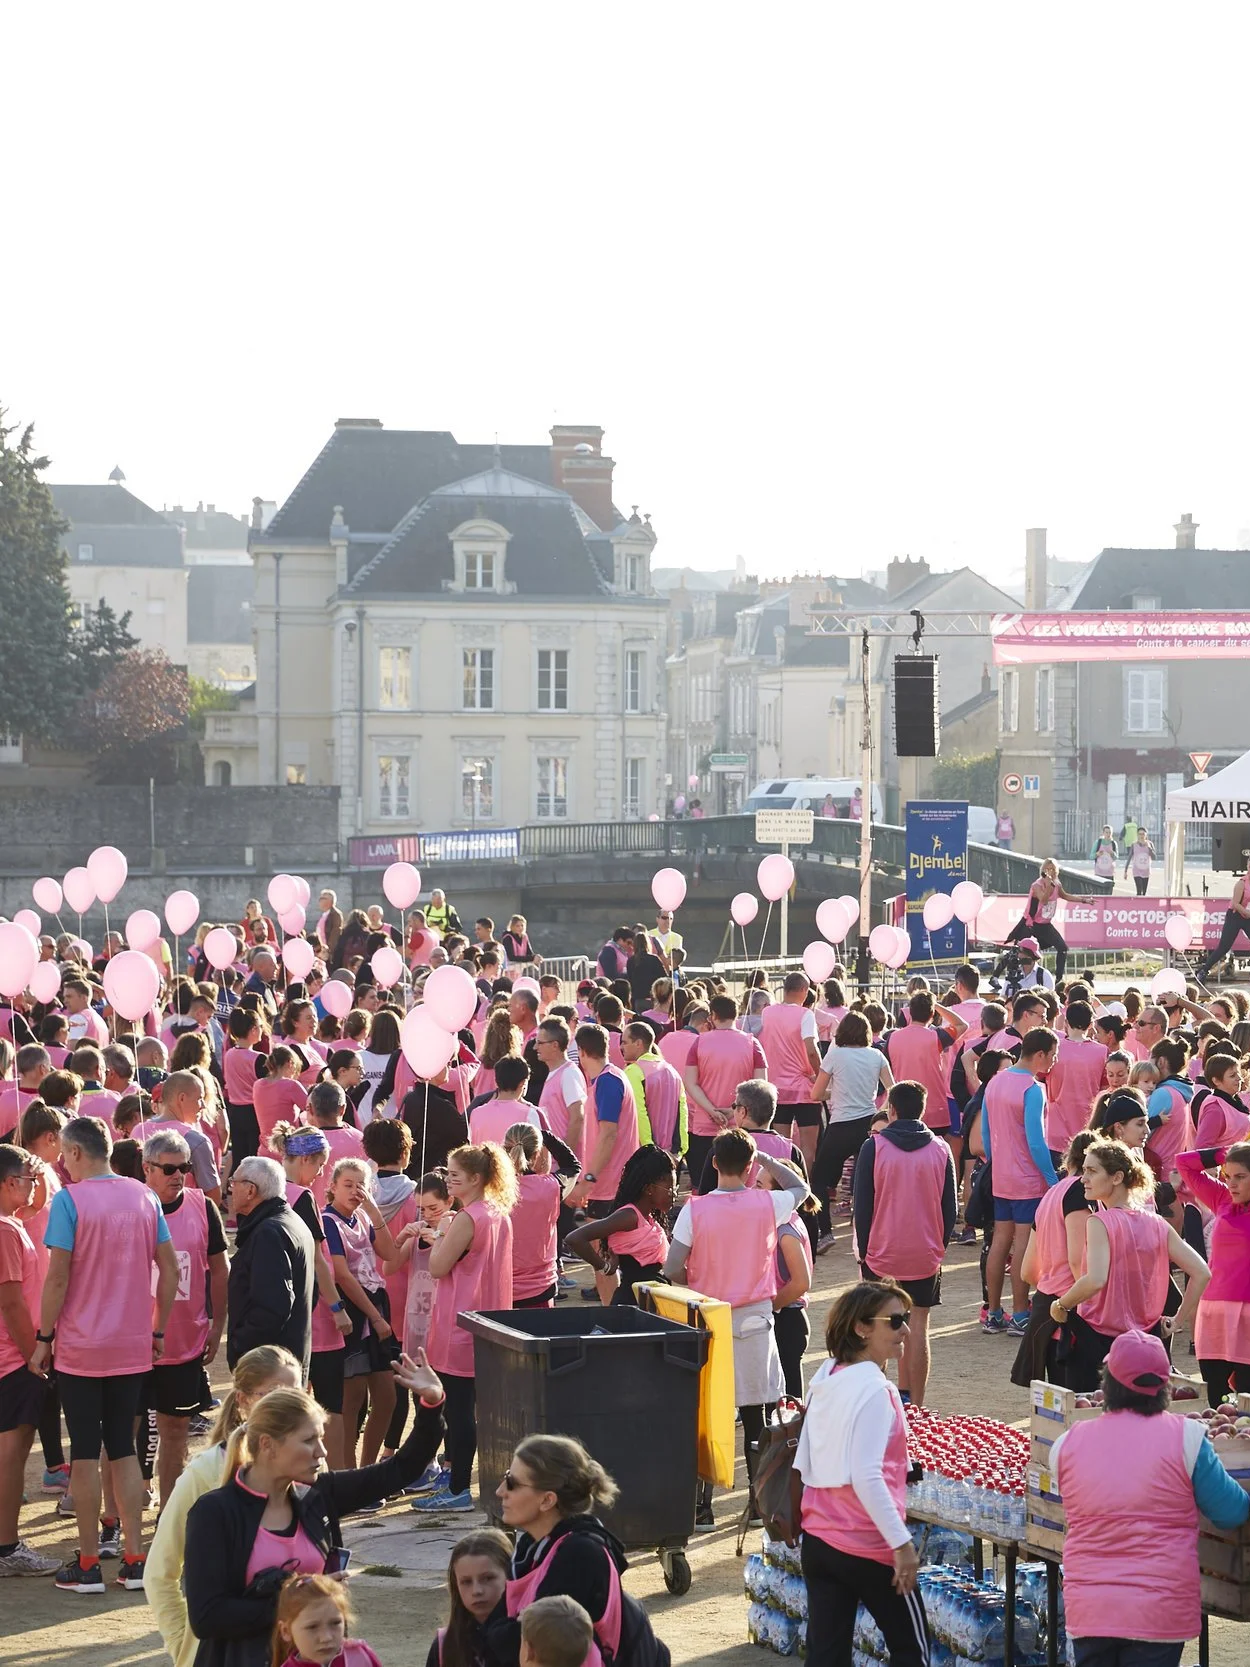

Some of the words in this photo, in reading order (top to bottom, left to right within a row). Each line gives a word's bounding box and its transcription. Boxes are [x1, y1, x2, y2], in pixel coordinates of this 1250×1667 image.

[1136, 638, 1170, 649] Contre
[1173, 638, 1184, 648] le
[1187, 638, 1221, 648] cancer
[1225, 637, 1238, 648] du
[910, 852, 967, 878] Djembel
[1106, 926, 1139, 938] Contre
[1142, 926, 1151, 938] le
[147, 1434, 159, 1452] DO
